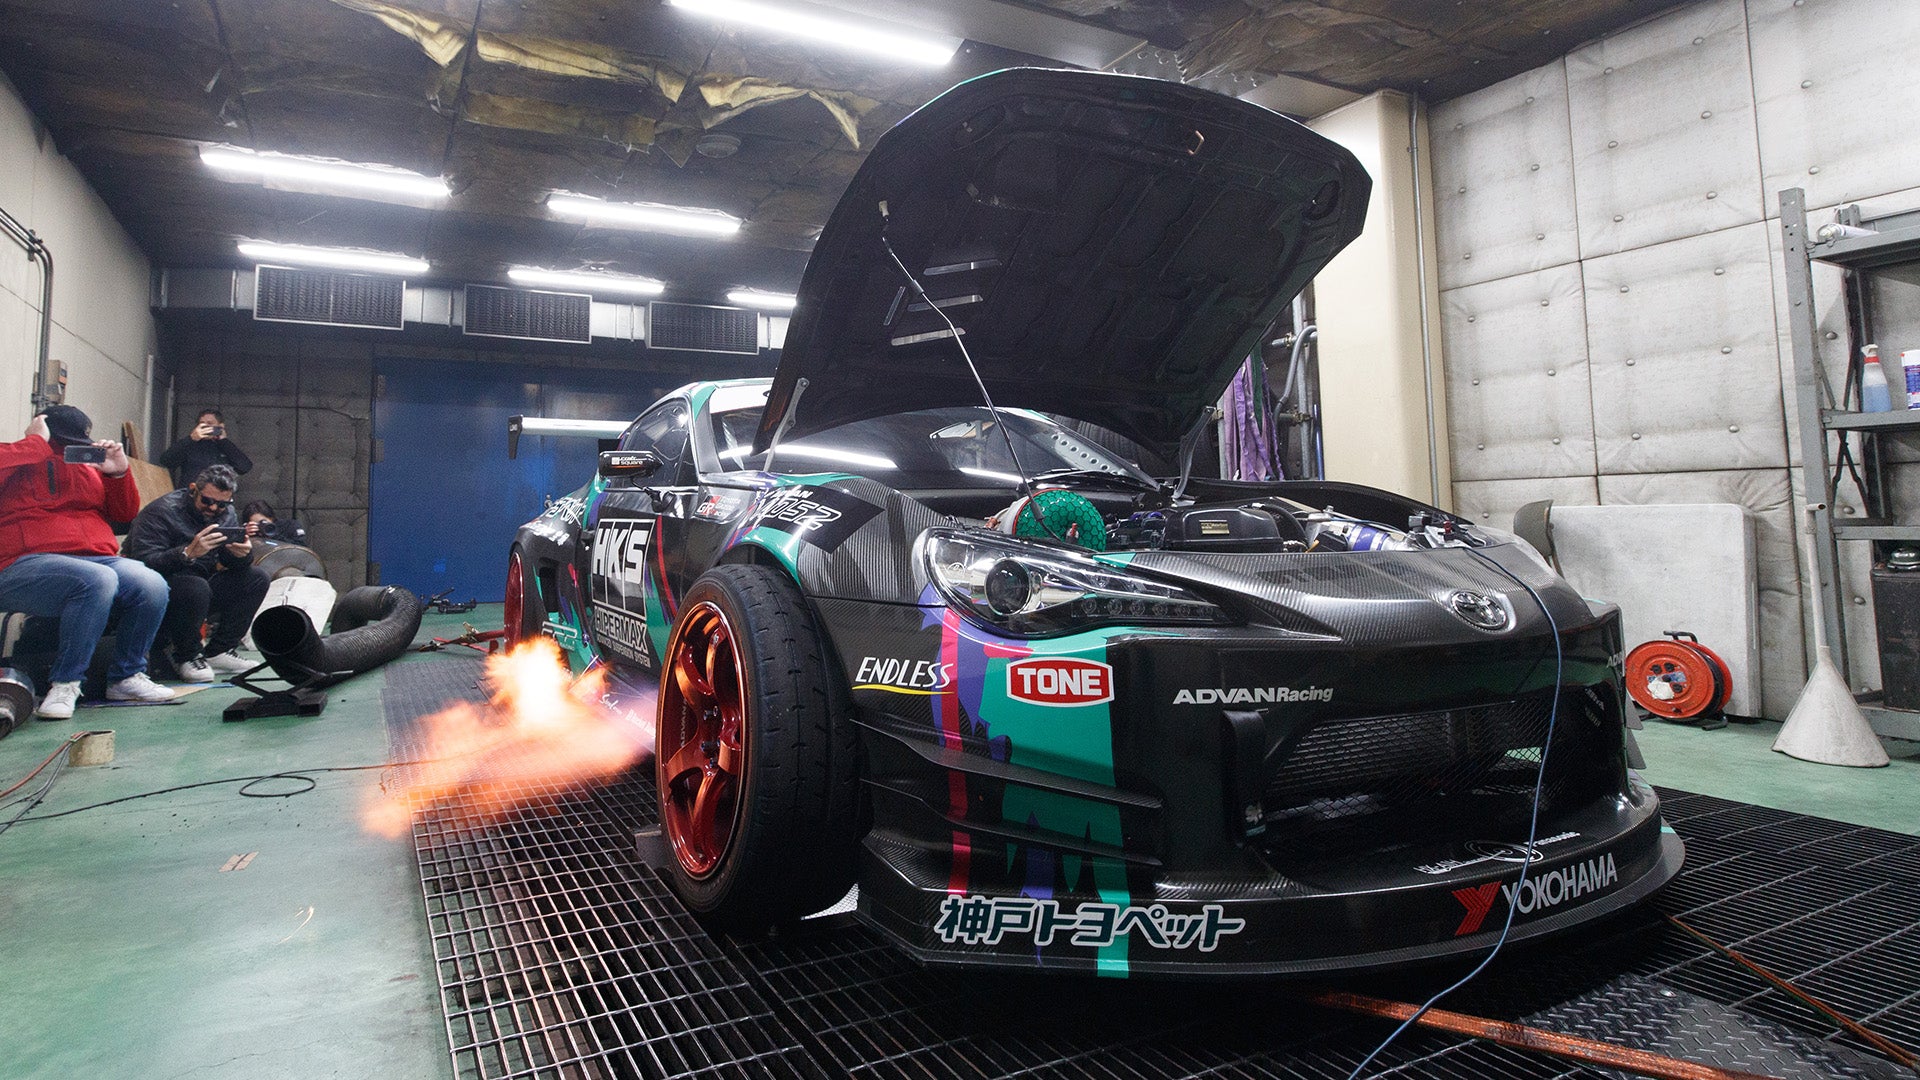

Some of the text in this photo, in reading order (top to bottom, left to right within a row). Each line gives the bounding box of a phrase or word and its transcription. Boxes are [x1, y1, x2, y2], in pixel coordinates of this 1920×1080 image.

[593, 527, 650, 585] HKS
[594, 606, 649, 655] HIPERMAX
[855, 656, 954, 689] ENDLESS
[1017, 667, 1103, 697] TONE
[1501, 852, 1619, 914] YOKOHAMA
[934, 895, 1246, 952] 神戸トヨペット
